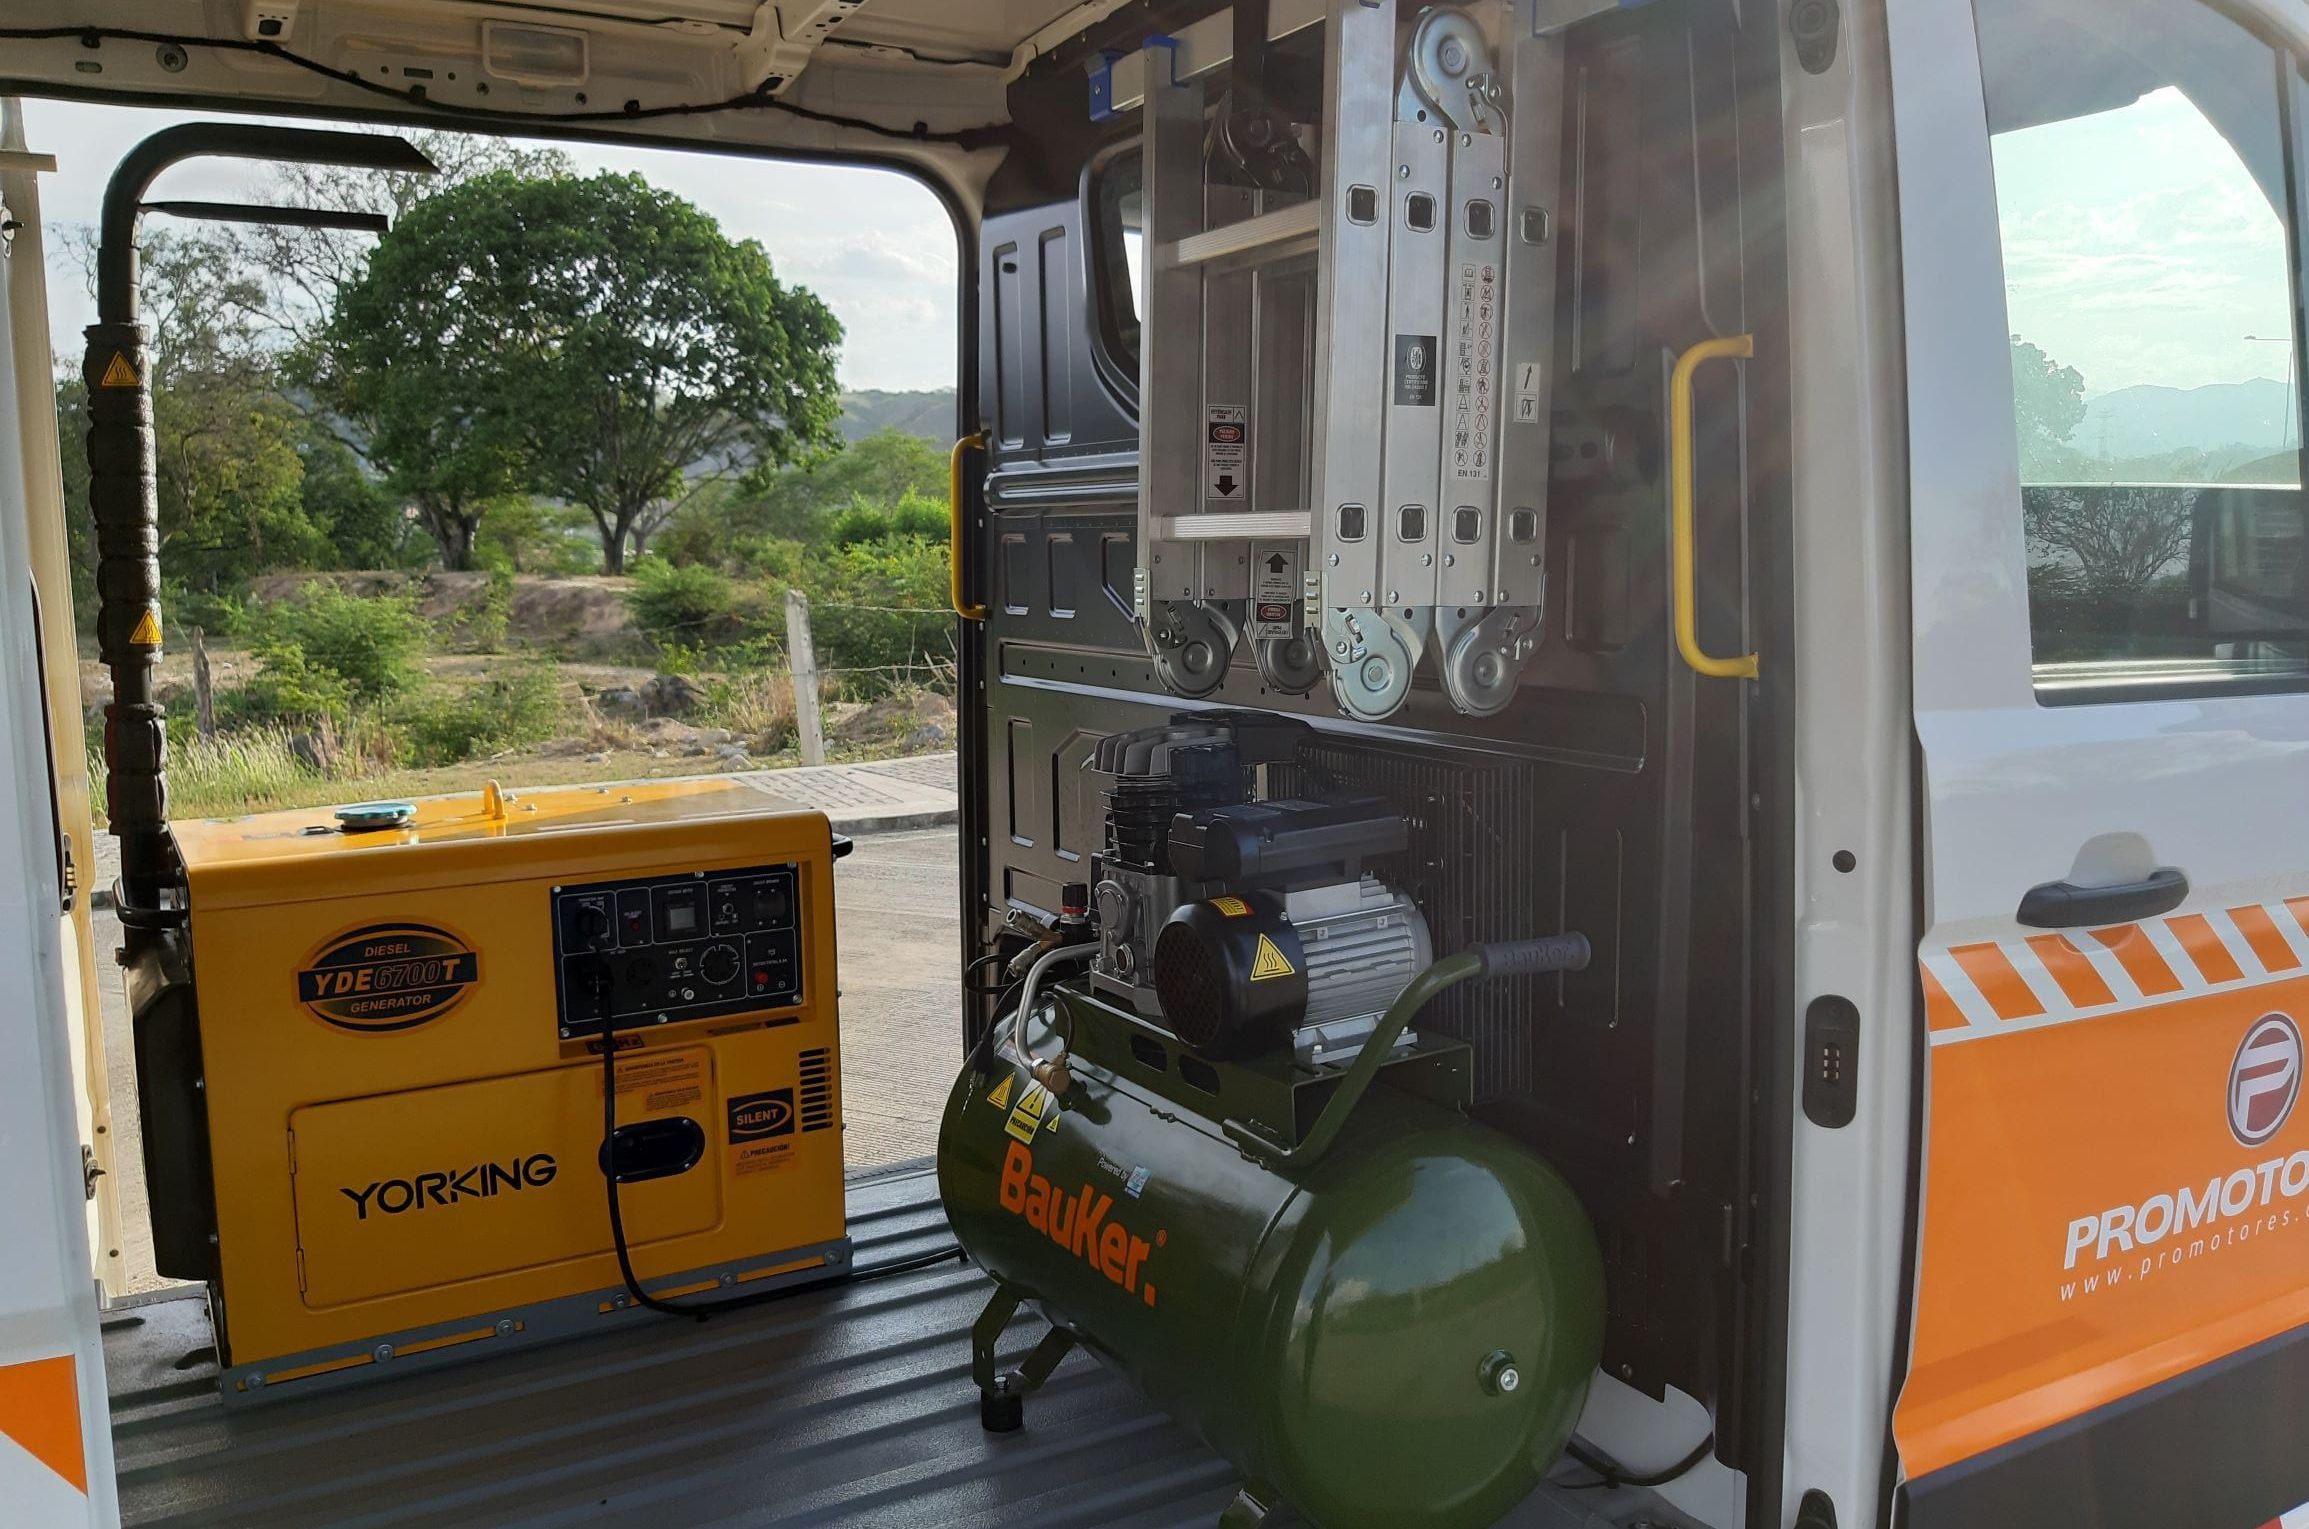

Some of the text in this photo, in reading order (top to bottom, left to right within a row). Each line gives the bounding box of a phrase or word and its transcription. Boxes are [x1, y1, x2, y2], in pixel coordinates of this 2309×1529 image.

[1457, 469, 1480, 478] EN 131
[364, 943, 411, 958] DIESEL
[314, 958, 461, 996] YDE6700T
[351, 994, 432, 1014] GENERATOR
[736, 1108, 778, 1126] SILENT
[1097, 1157, 1130, 1182] Powered by
[339, 1153, 558, 1220] YORKING
[2063, 1150, 2309, 1270] PROMOTO
